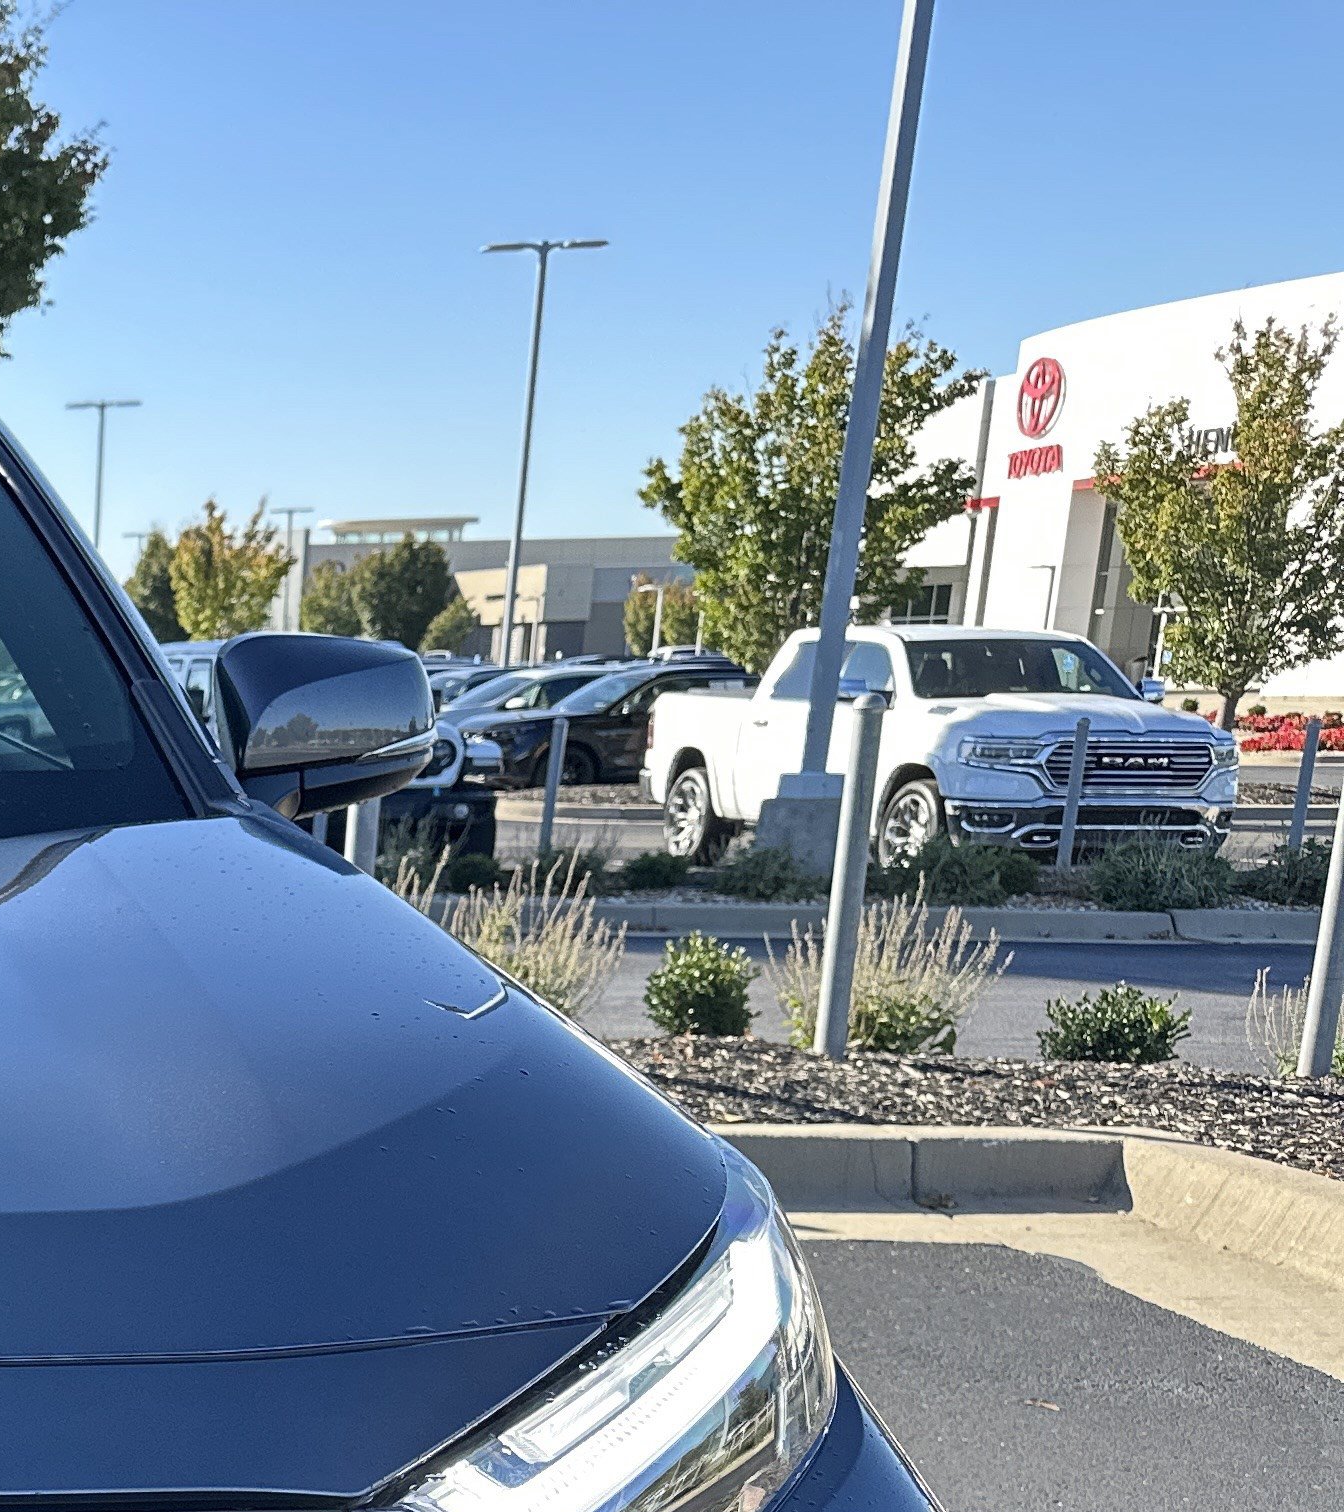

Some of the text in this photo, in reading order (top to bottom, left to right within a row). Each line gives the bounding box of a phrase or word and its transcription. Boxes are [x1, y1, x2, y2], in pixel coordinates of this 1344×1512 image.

[1188, 422, 1238, 456] HEN
[1007, 444, 1063, 479] TOYOTA
[1101, 756, 1169, 769] RAM
